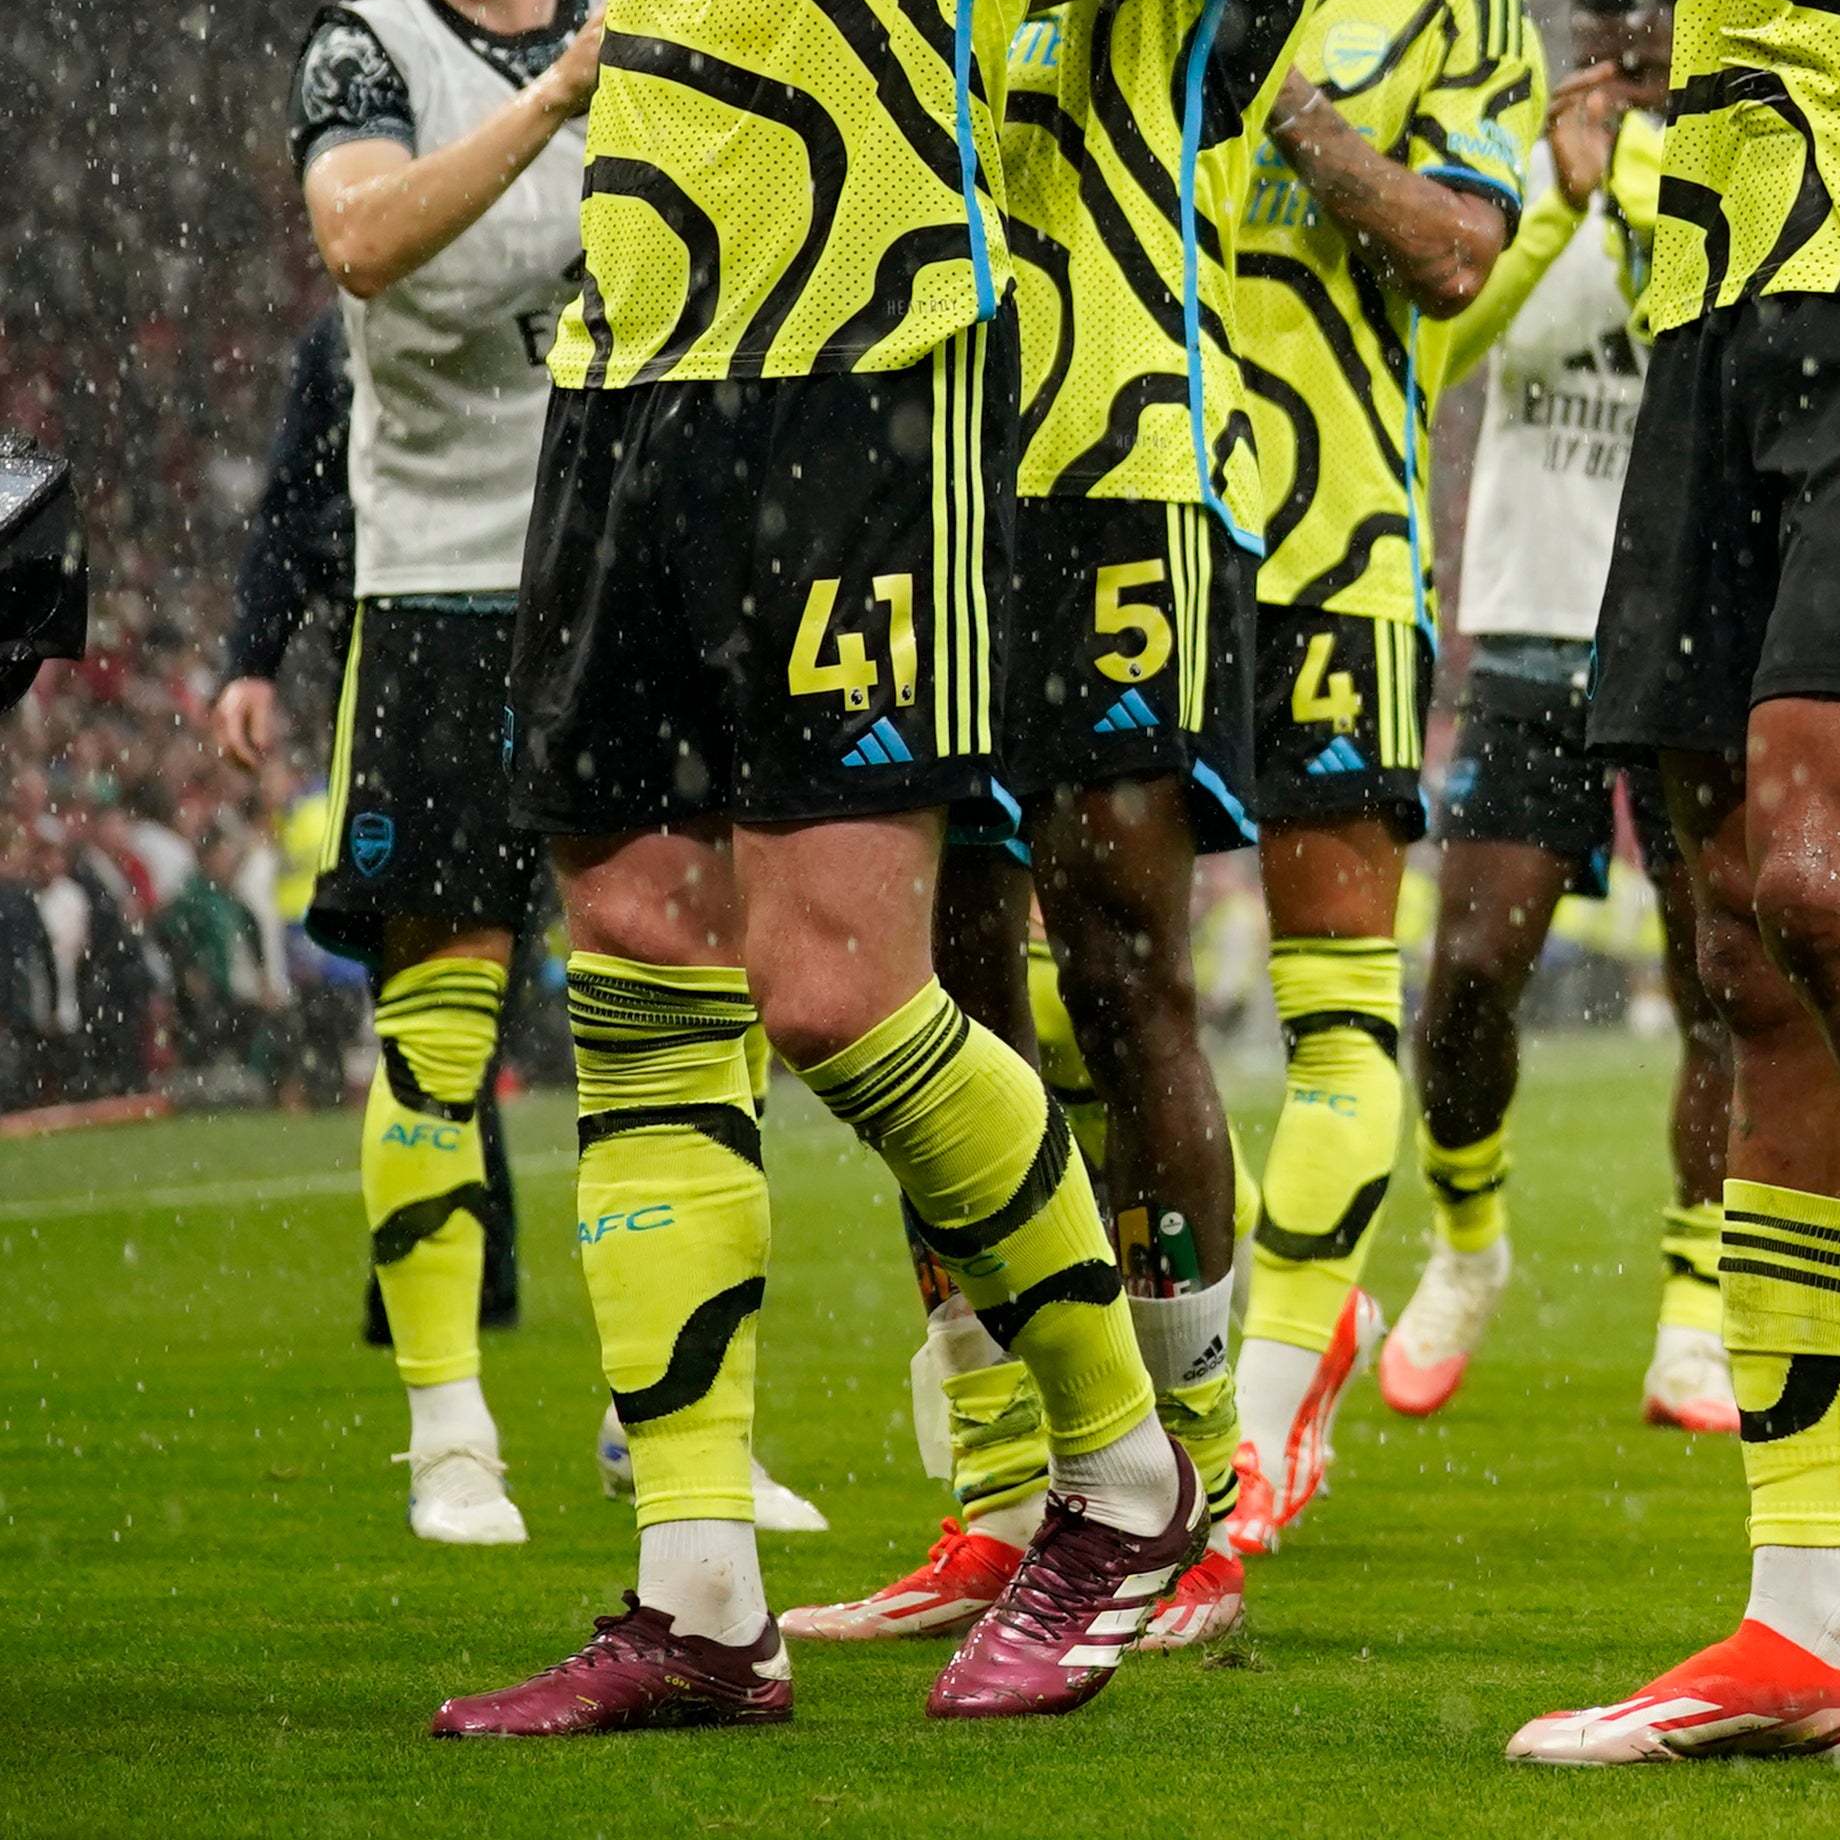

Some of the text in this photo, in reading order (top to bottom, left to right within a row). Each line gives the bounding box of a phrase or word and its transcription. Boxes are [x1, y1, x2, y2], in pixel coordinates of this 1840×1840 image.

[787, 572, 919, 712] 41
[1094, 558, 1173, 683] 5
[1291, 632, 1363, 733] 4
[381, 1122, 461, 1151] AFC
[578, 1204, 675, 1244] AFC
